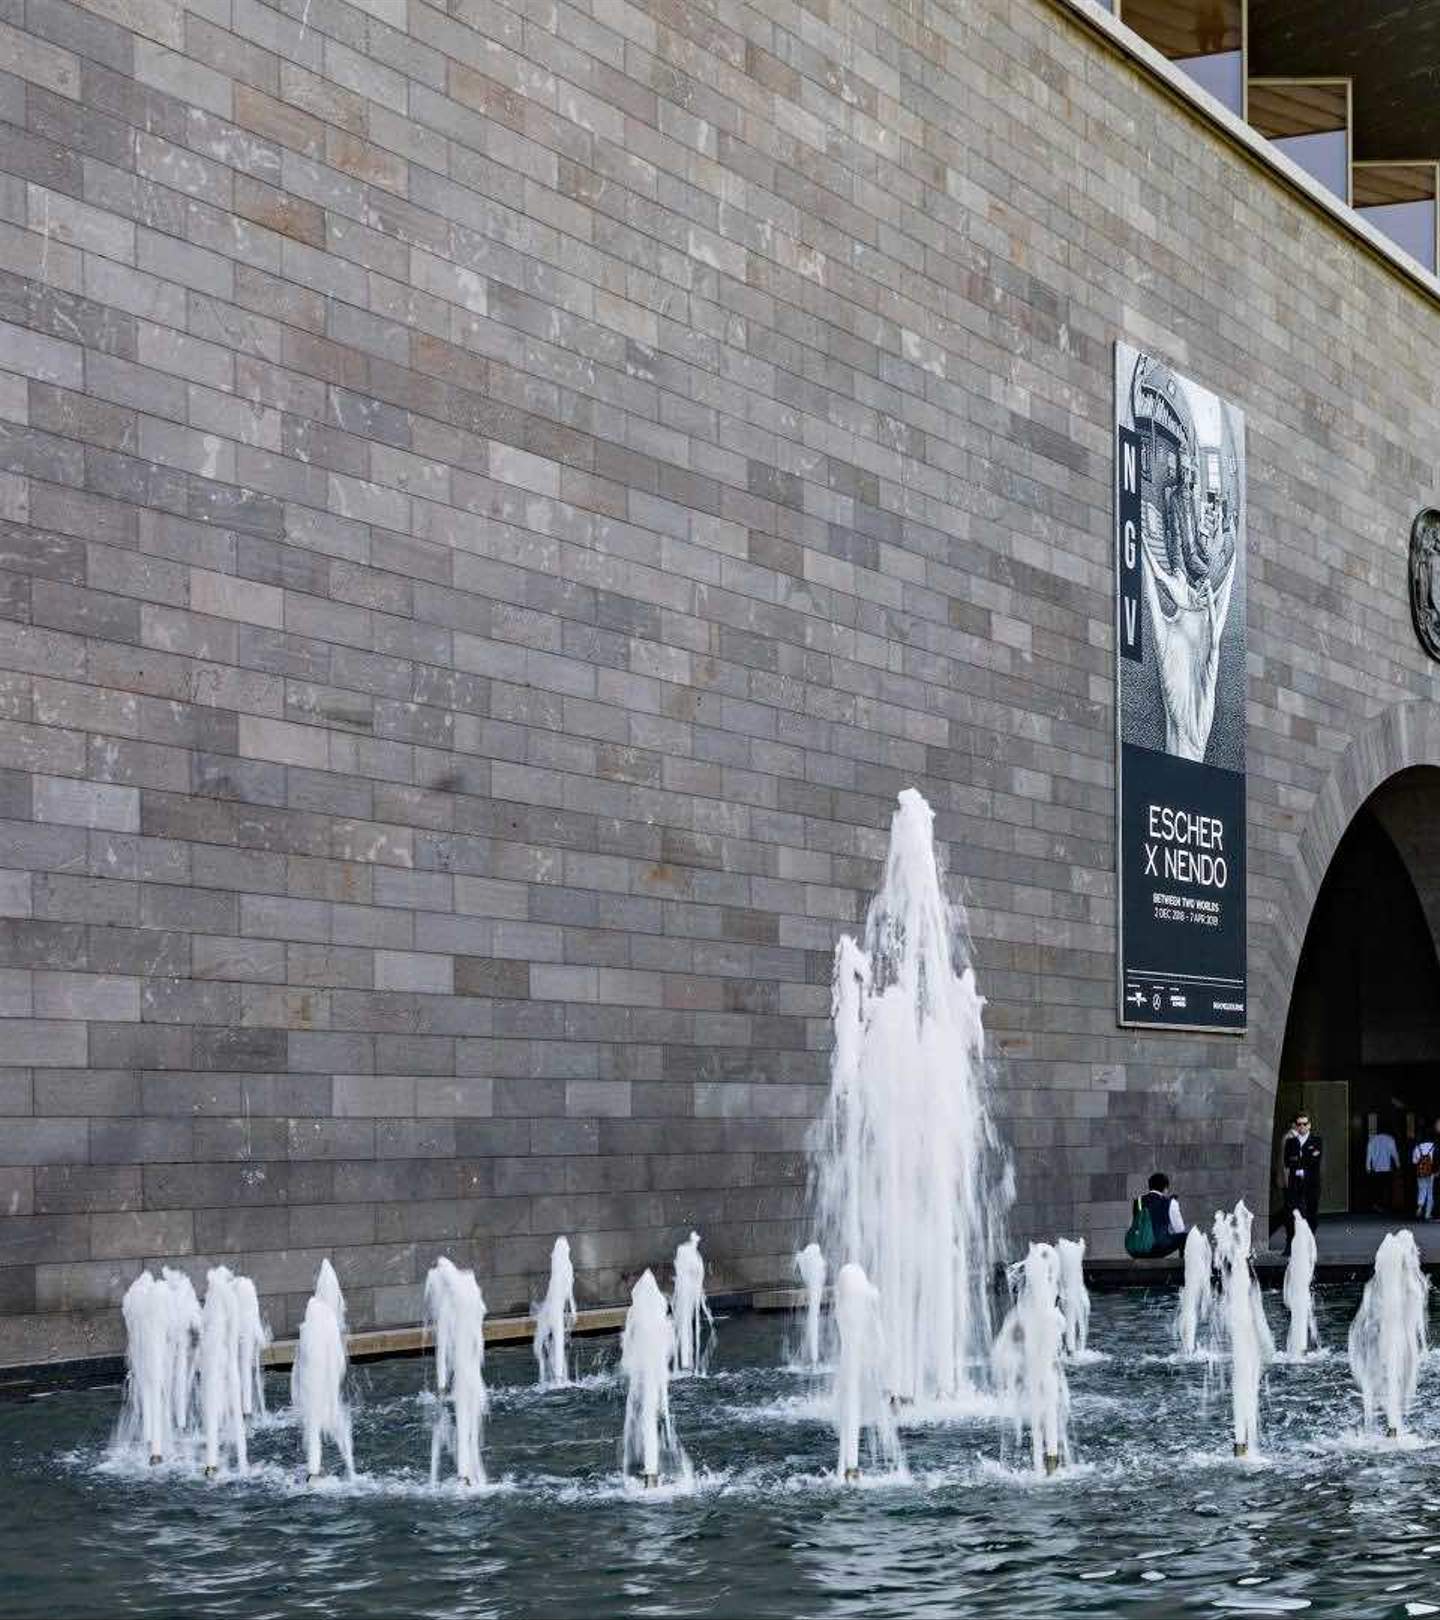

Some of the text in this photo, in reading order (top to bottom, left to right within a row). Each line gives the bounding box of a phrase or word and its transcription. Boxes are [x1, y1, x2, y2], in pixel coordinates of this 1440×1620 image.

[1149, 805, 1224, 851] ESCHER
[1144, 842, 1228, 889] X NENDO
[1159, 907, 1171, 919] DEC
[1182, 897, 1195, 909] TWO
